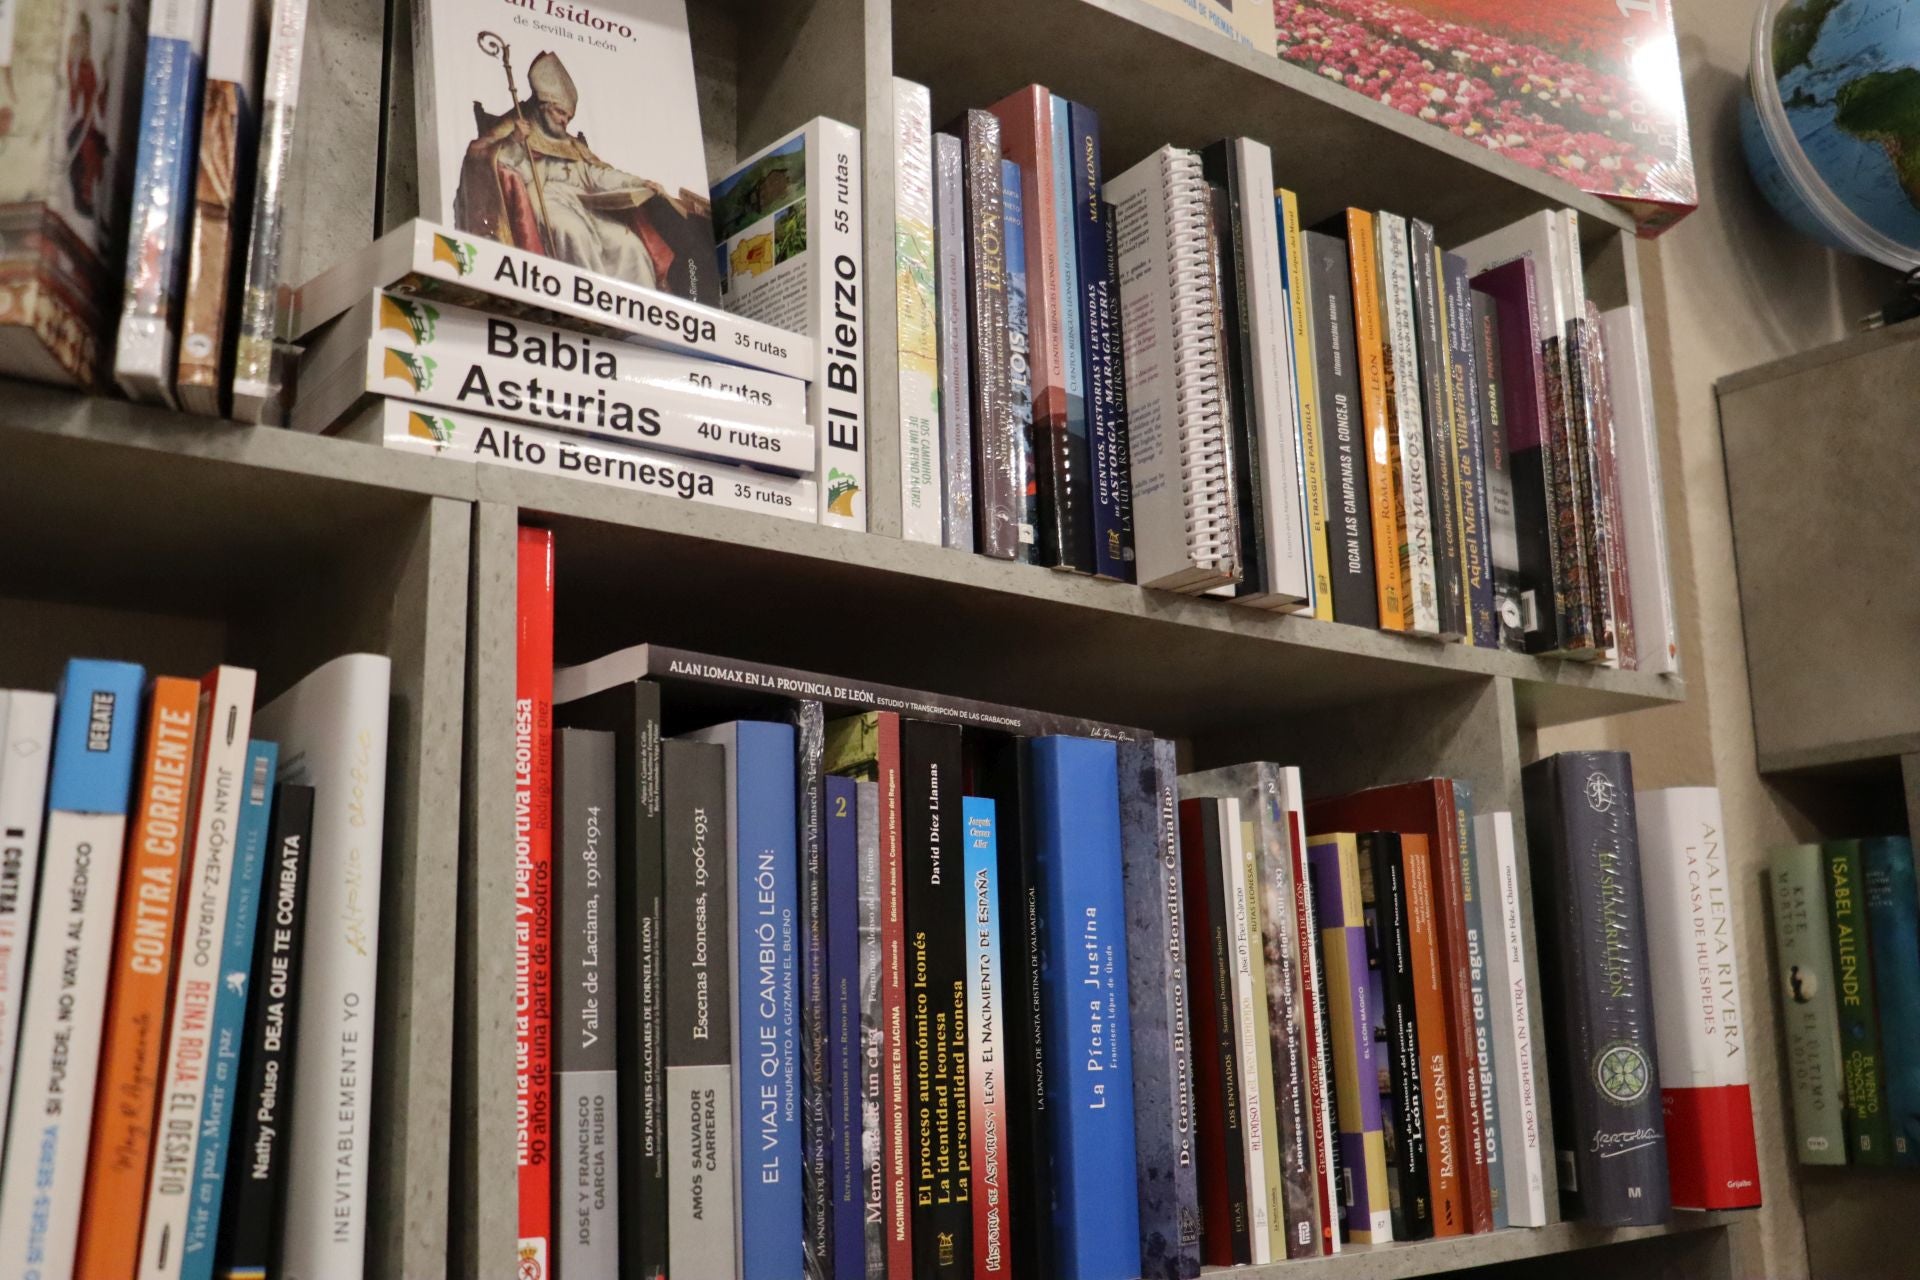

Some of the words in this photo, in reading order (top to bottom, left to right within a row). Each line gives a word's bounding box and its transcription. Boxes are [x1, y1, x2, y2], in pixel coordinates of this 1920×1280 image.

[513, 14, 529, 26] de
[533, 19, 574, 39] Sevilla
[588, 36, 617, 52] León
[547, 0, 638, 42] Isidoro,
[834, 153, 849, 203] rutas
[1085, 135, 1097, 191] ALONSO
[834, 208, 849, 234] 55
[1090, 193, 1098, 223] MAX
[494, 256, 561, 297] Alto
[574, 276, 717, 343] Bernesga
[734, 333, 751, 349] 35
[754, 339, 788, 359] rutas
[827, 254, 858, 394] Bierzo
[1088, 284, 1099, 350] LEYENDAS
[487, 318, 619, 382] Babia
[689, 373, 713, 390] 50
[1009, 332, 1027, 387] LOIS
[1098, 280, 1114, 405] MARAGATERÍA
[457, 364, 662, 438] Asturias
[697, 421, 722, 443] 40
[729, 428, 782, 453] rutas
[920, 418, 929, 438] NOS
[1094, 366, 1104, 438] HISTORIAS
[1336, 394, 1350, 441] CONCEJO
[1454, 364, 1469, 449] Villafranca
[1489, 384, 1499, 426] ESPAÑA
[828, 414, 858, 452] El
[1305, 403, 1315, 458] PARADILLA
[474, 427, 546, 465] Alto
[558, 440, 715, 499] Bernesga
[734, 484, 752, 499] 35
[755, 488, 793, 507] rutas
[909, 448, 919, 475] REINO
[921, 440, 932, 485] CAMINHOS
[1098, 441, 1109, 505] CUENTOS,
[1108, 420, 1120, 502] ASTORGA
[1340, 455, 1357, 514] CAMPANAS
[1407, 431, 1425, 518] MARCOS
[1380, 477, 1392, 519] ROMA
[1348, 539, 1362, 574] TOCAN
[1419, 527, 1428, 566] SAN
[1469, 536, 1482, 589] Aquel
[670, 660, 701, 675] ALAN
[704, 666, 743, 683] LOMAX
[778, 679, 832, 697] PROVINCIA
[515, 699, 531, 785] Leonesa
[144, 708, 192, 858] CORRIENTE
[536, 778, 550, 830] Rodrigo
[835, 796, 847, 817] 2
[929, 763, 939, 810] Llamas
[582, 806, 601, 888] 1918-1924
[692, 808, 708, 887] 1906-1931
[930, 816, 940, 844] Díez
[1458, 809, 1470, 855] Huerta
[1701, 823, 1721, 879] ANA
[70, 842, 93, 913] MÉDICO
[194, 818, 227, 967] GÓMEZ-JURADO
[276, 834, 301, 926] COMBATA
[754, 850, 775, 915] LEÓN:
[931, 847, 940, 885] David
[1247, 863, 1256, 904] LEONESAS
[1462, 859, 1472, 902] Benito
[1832, 858, 1851, 918] ISABEL
[131, 868, 174, 976] CONTRA
[532, 861, 548, 939] nosotros
[974, 868, 989, 924] ESPAÑA
[1709, 888, 1728, 954] LENA
[582, 893, 600, 966] Laciana,
[783, 909, 792, 951] BUENO
[867, 912, 876, 947] Alonso
[1084, 907, 1101, 989] Justina
[1300, 930, 1310, 974] TESORO
[1396, 928, 1404, 973] Maximiano
[1468, 929, 1483, 981] agua
[62, 947, 81, 988] VAYA
[582, 971, 598, 994] de
[643, 955, 652, 1003] FORNELA
[755, 923, 776, 1018] CAMBIÓ
[913, 932, 927, 988] leonés
[1282, 960, 1292, 1005] Ciencia
[1838, 924, 1860, 1006] ALLENDE
[264, 999, 285, 1052] DEJA
[342, 992, 360, 1022] YO
[582, 1000, 598, 1048] Valle
[693, 990, 708, 1040] Escenas
[782, 973, 792, 1026] GUZMÁN
[892, 1006, 900, 1046] LACIANA
[953, 980, 965, 1046] leonesa
[980, 955, 992, 1044] NACIMIENTO
[1173, 984, 1185, 1052] Blanco
[1219, 1001, 1229, 1033] Santiago
[1358, 986, 1367, 1021] MÁGICO
[1472, 987, 1486, 1021] del
[1717, 963, 1740, 1058] RIVERA
[644, 1024, 652, 1083] GLACIARES
[761, 1026, 779, 1077] QUE
[867, 1027, 879, 1072] cura
[915, 994, 929, 1102] autonómico
[936, 1012, 947, 1079] leonesa
[1087, 1000, 1104, 1071] Pícara
[1396, 1004, 1406, 1052] patrimonio
[1406, 1021, 1420, 1080] provincia
[784, 1040, 793, 1121] MONUMENTO
[1224, 1054, 1236, 1108] ENVIADOS
[1288, 1038, 1299, 1085] historia
[1431, 1055, 1448, 1120] LEONÉS
[1468, 1067, 1478, 1108] PIEDRA
[1476, 1026, 1494, 1120] mugidos
[1521, 1043, 1534, 1108] PROPHETA
[258, 1060, 279, 1124] Peluso
[644, 1086, 653, 1133] PAISAJES
[762, 1085, 778, 1150] VIAJE
[953, 1052, 970, 1171] personalidad
[1090, 1083, 1106, 1109] La
[1178, 1058, 1189, 1133] Genaro
[1314, 1099, 1324, 1140] GARCÍA
[1411, 1094, 1423, 1140] León
[332, 1028, 359, 1242] INEVITABLEMENTE
[579, 1096, 589, 1186] FRANCISCO
[594, 1095, 604, 1146] RUBIO
[691, 1090, 702, 1169] SALVADOR
[705, 1089, 716, 1172] CARRERAS
[894, 1113, 904, 1174] MATRIMONIO
[919, 1109, 934, 1180] proceso
[936, 1085, 949, 1172] identidad
[1293, 1117, 1305, 1174] Leoneses
[1473, 1127, 1483, 1165] HABLA
[1484, 1126, 1497, 1163] Los
[187, 1207, 210, 1253] Vivir
[203, 1086, 224, 1138] Morir
[763, 1157, 779, 1183] EL
[867, 1128, 882, 1224] Memorias
[1179, 1139, 1190, 1167] De
[1317, 1141, 1326, 1174] GEMA
[1438, 1124, 1453, 1177] RAMO
[594, 1151, 604, 1210] GARCÍA
[692, 1175, 703, 1220] AMÓS
[919, 1186, 932, 1206] El
[938, 1179, 950, 1204] La
[956, 1178, 968, 1202] La
[986, 1208, 1001, 1271] HISTORIA
